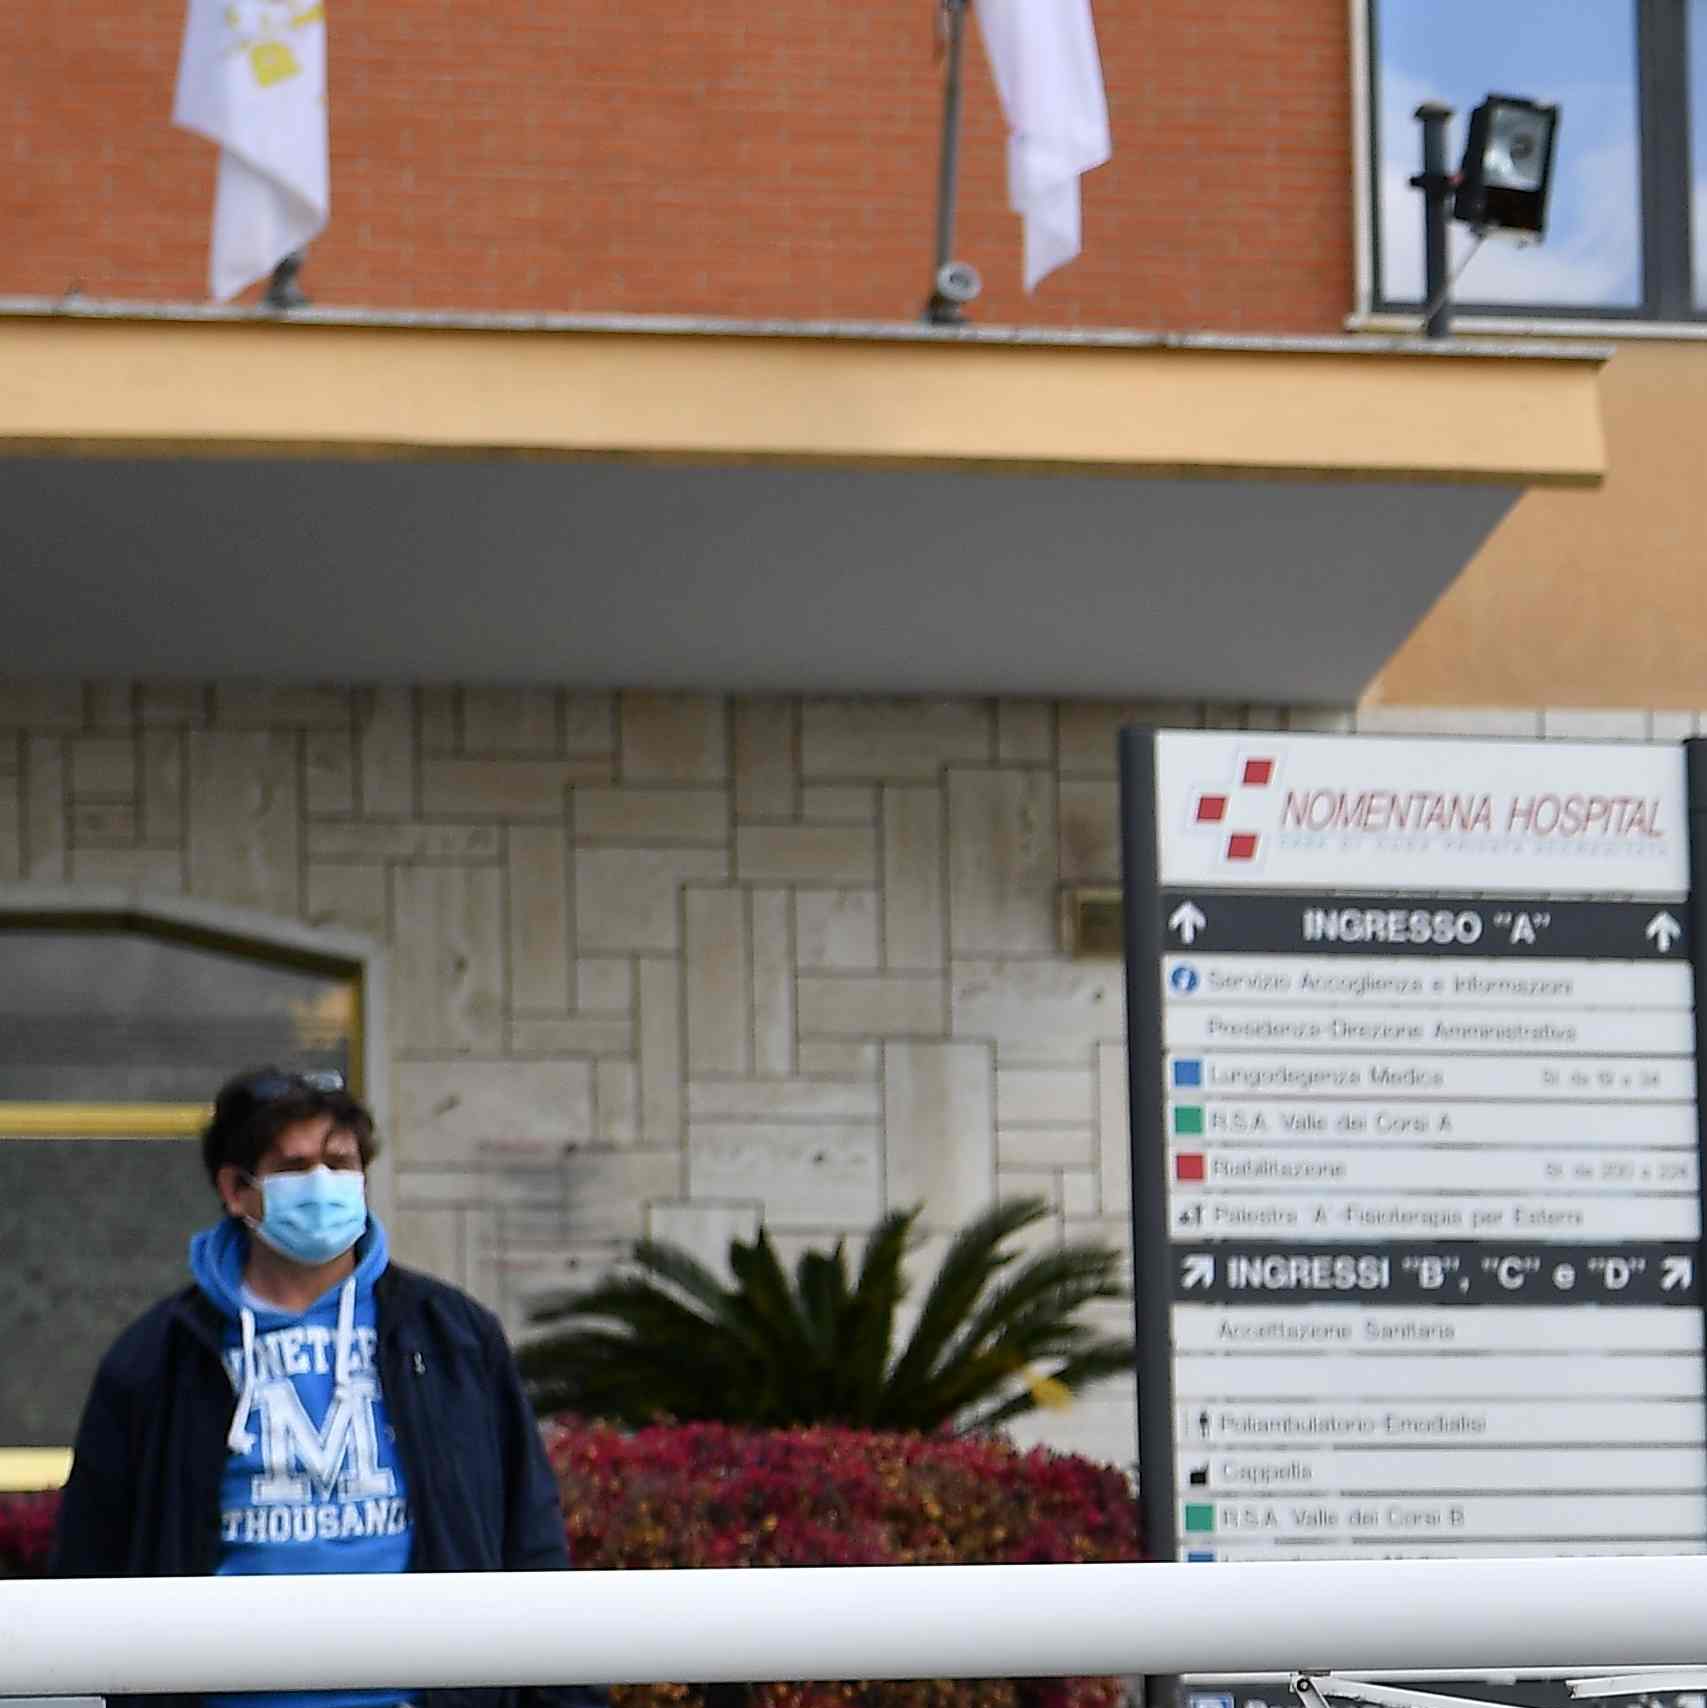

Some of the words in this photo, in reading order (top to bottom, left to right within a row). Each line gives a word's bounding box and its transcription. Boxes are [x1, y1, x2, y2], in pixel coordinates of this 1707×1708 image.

[1281, 789, 1492, 833] NOMENTANA
[1505, 793, 1664, 838] HOSPITAL
[1301, 908, 1483, 944] INGRESSO
[1493, 911, 1551, 944] "A"
[1226, 1255, 1390, 1289] INGRESSI
[1552, 1263, 1576, 1290] e
[249, 1377, 397, 1505] M
